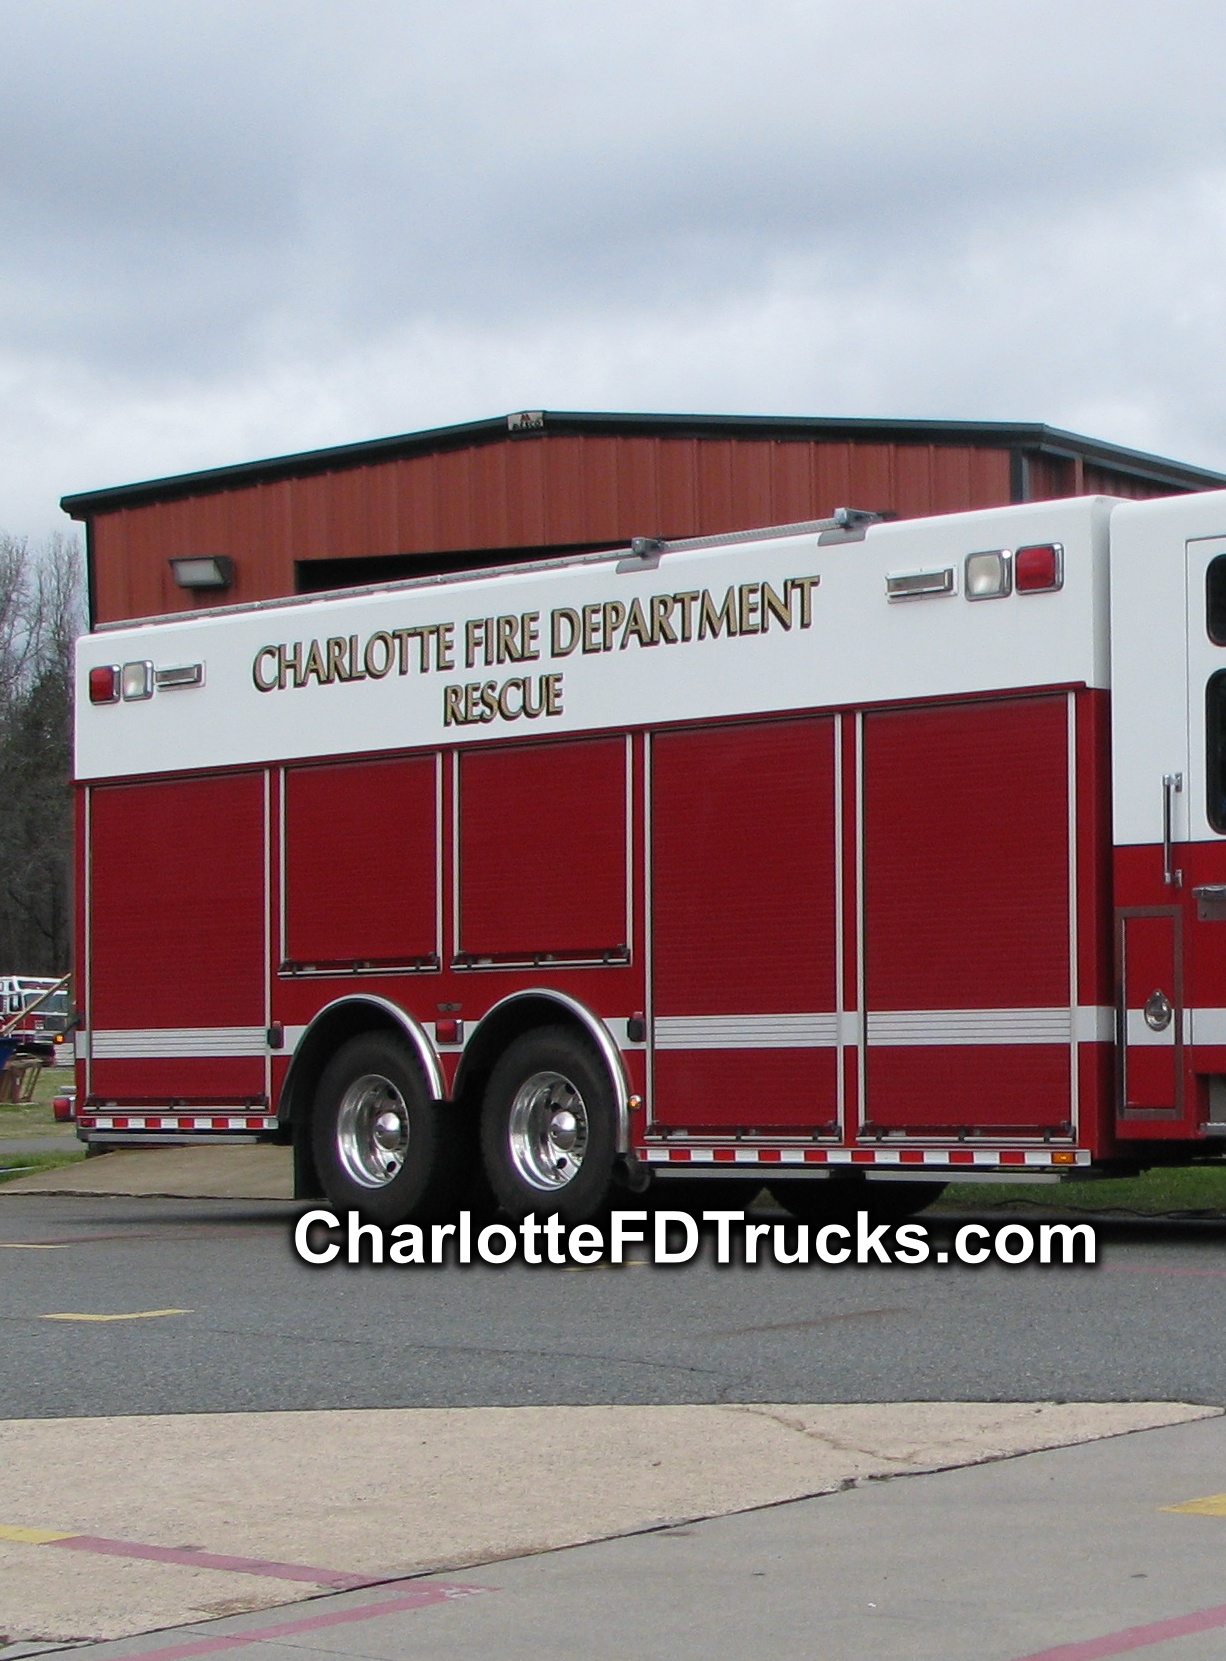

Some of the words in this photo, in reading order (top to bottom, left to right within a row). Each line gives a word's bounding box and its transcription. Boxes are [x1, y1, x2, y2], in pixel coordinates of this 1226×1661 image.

[252, 621, 456, 692] CHARLOTTE
[465, 611, 541, 667] FIRE
[551, 575, 822, 657] DEPARTMENT
[443, 673, 565, 727] RESCUE
